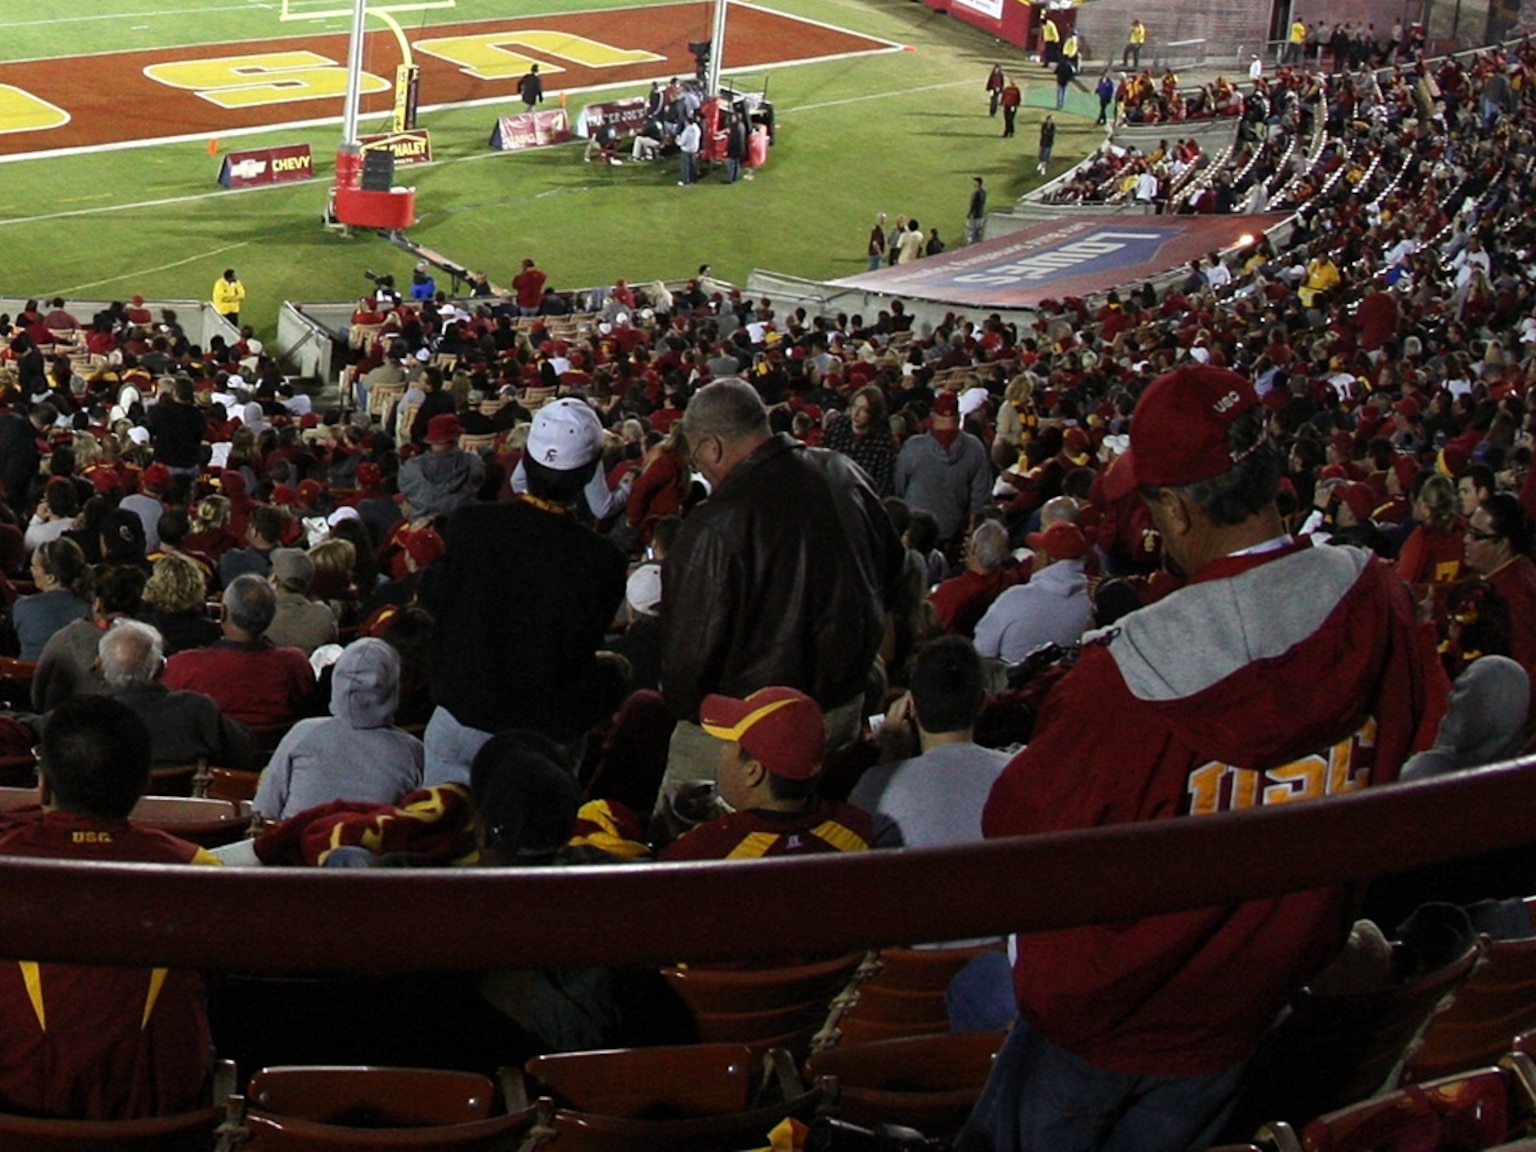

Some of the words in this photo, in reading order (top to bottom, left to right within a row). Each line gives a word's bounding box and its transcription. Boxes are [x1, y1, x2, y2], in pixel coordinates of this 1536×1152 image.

[272, 156, 310, 172] CHEVY
[1212, 390, 1241, 413] USC
[1187, 716, 1377, 817] USC
[72, 831, 114, 844] USC
